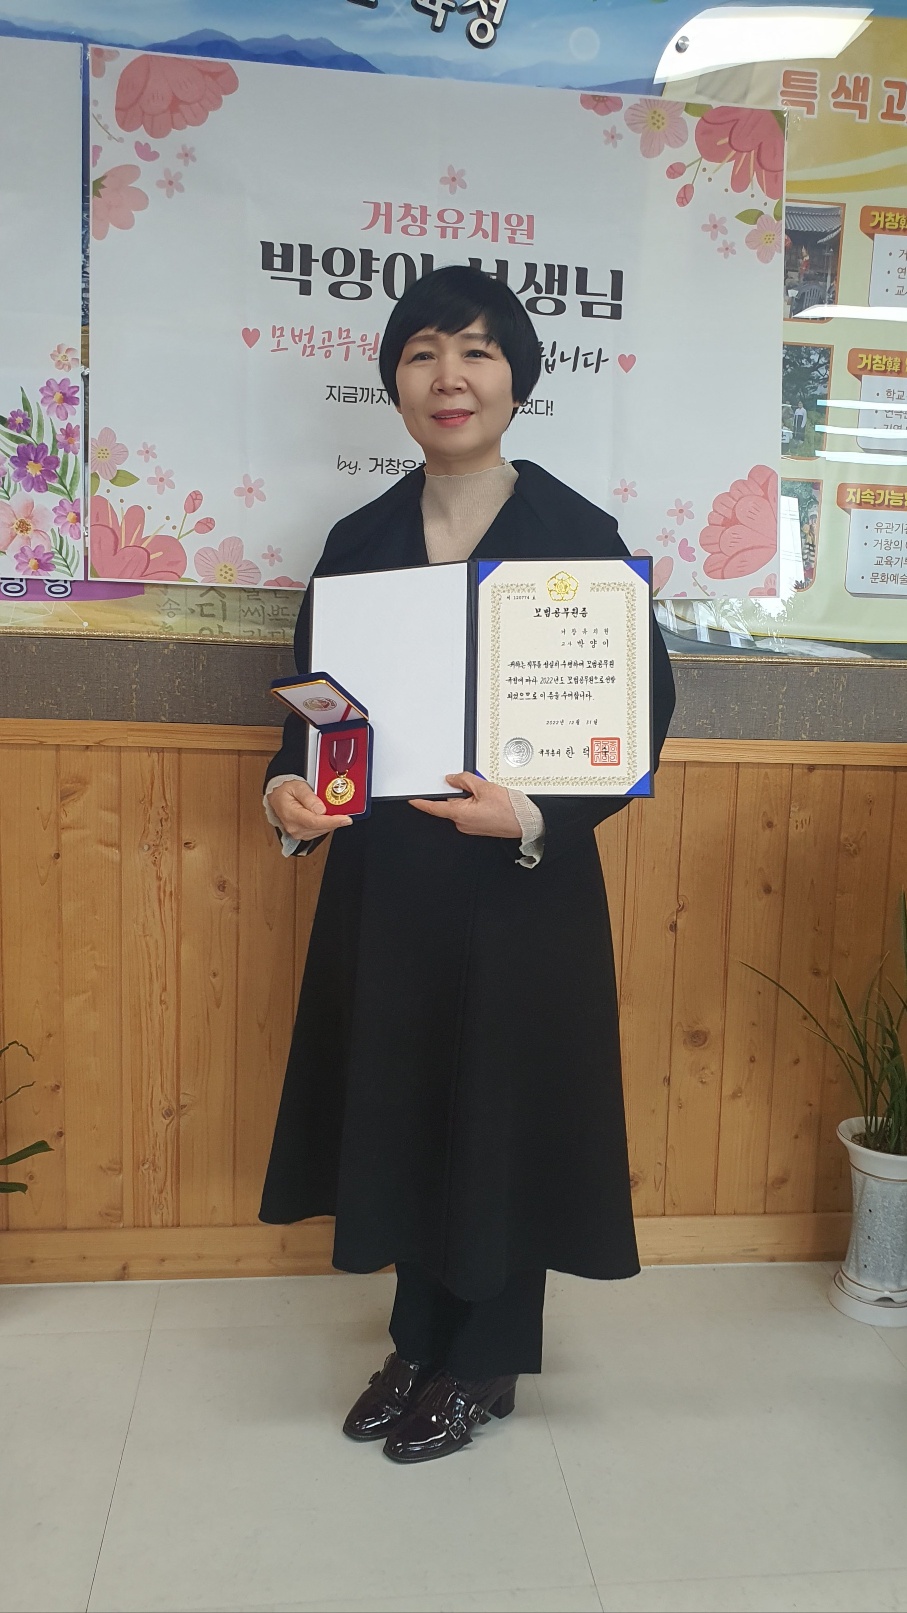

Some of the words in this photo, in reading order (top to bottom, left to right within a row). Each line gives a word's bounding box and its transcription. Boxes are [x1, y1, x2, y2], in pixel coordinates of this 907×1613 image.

[361, 200, 535, 246] 거창유치원
[260, 241, 434, 301] 박양이
[325, 385, 391, 405] 지금까지
[369, 457, 426, 475] 거창유
[846, 488, 907, 506] 지속가능
[873, 539, 903, 551] 거창의
[533, 606, 588, 618] 모범공무원증
[540, 675, 565, 685] 2022년도
[540, 691, 546, 701] 이
